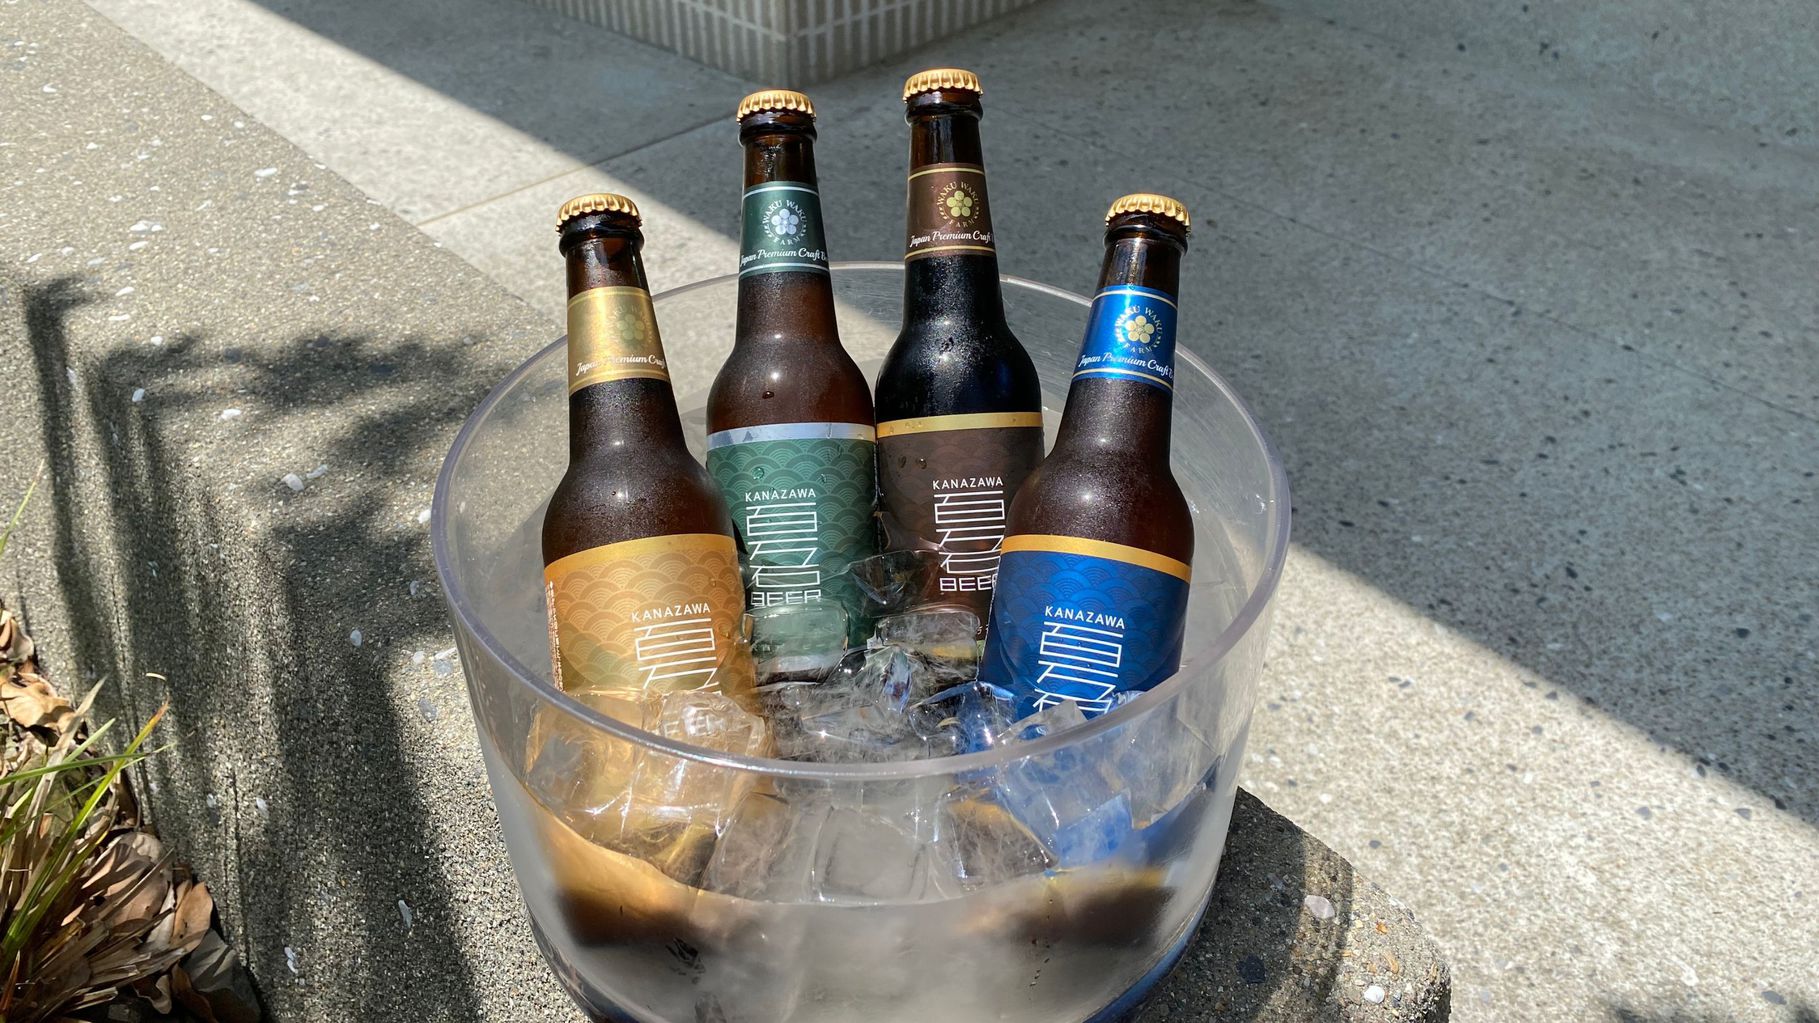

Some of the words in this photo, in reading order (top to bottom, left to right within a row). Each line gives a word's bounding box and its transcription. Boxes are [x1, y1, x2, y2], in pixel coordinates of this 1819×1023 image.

[937, 181, 958, 206] WAKU
[762, 199, 782, 224] WAKU
[772, 236, 802, 246] FARM
[909, 235, 931, 248] Japan
[932, 230, 972, 241] Premium
[740, 254, 757, 267] Japan
[757, 248, 797, 260] Premium
[798, 247, 821, 261] Craft
[575, 361, 602, 377] Japa
[1078, 354, 1102, 368] Japan
[1147, 359, 1170, 377] Craft
[931, 476, 1004, 490] KANAZAWA
[745, 488, 817, 502] KANAZAWA
[751, 588, 822, 607] BEER
[631, 602, 711, 623] KANAZAWA
[1044, 605, 1126, 629] KANAZAWA
